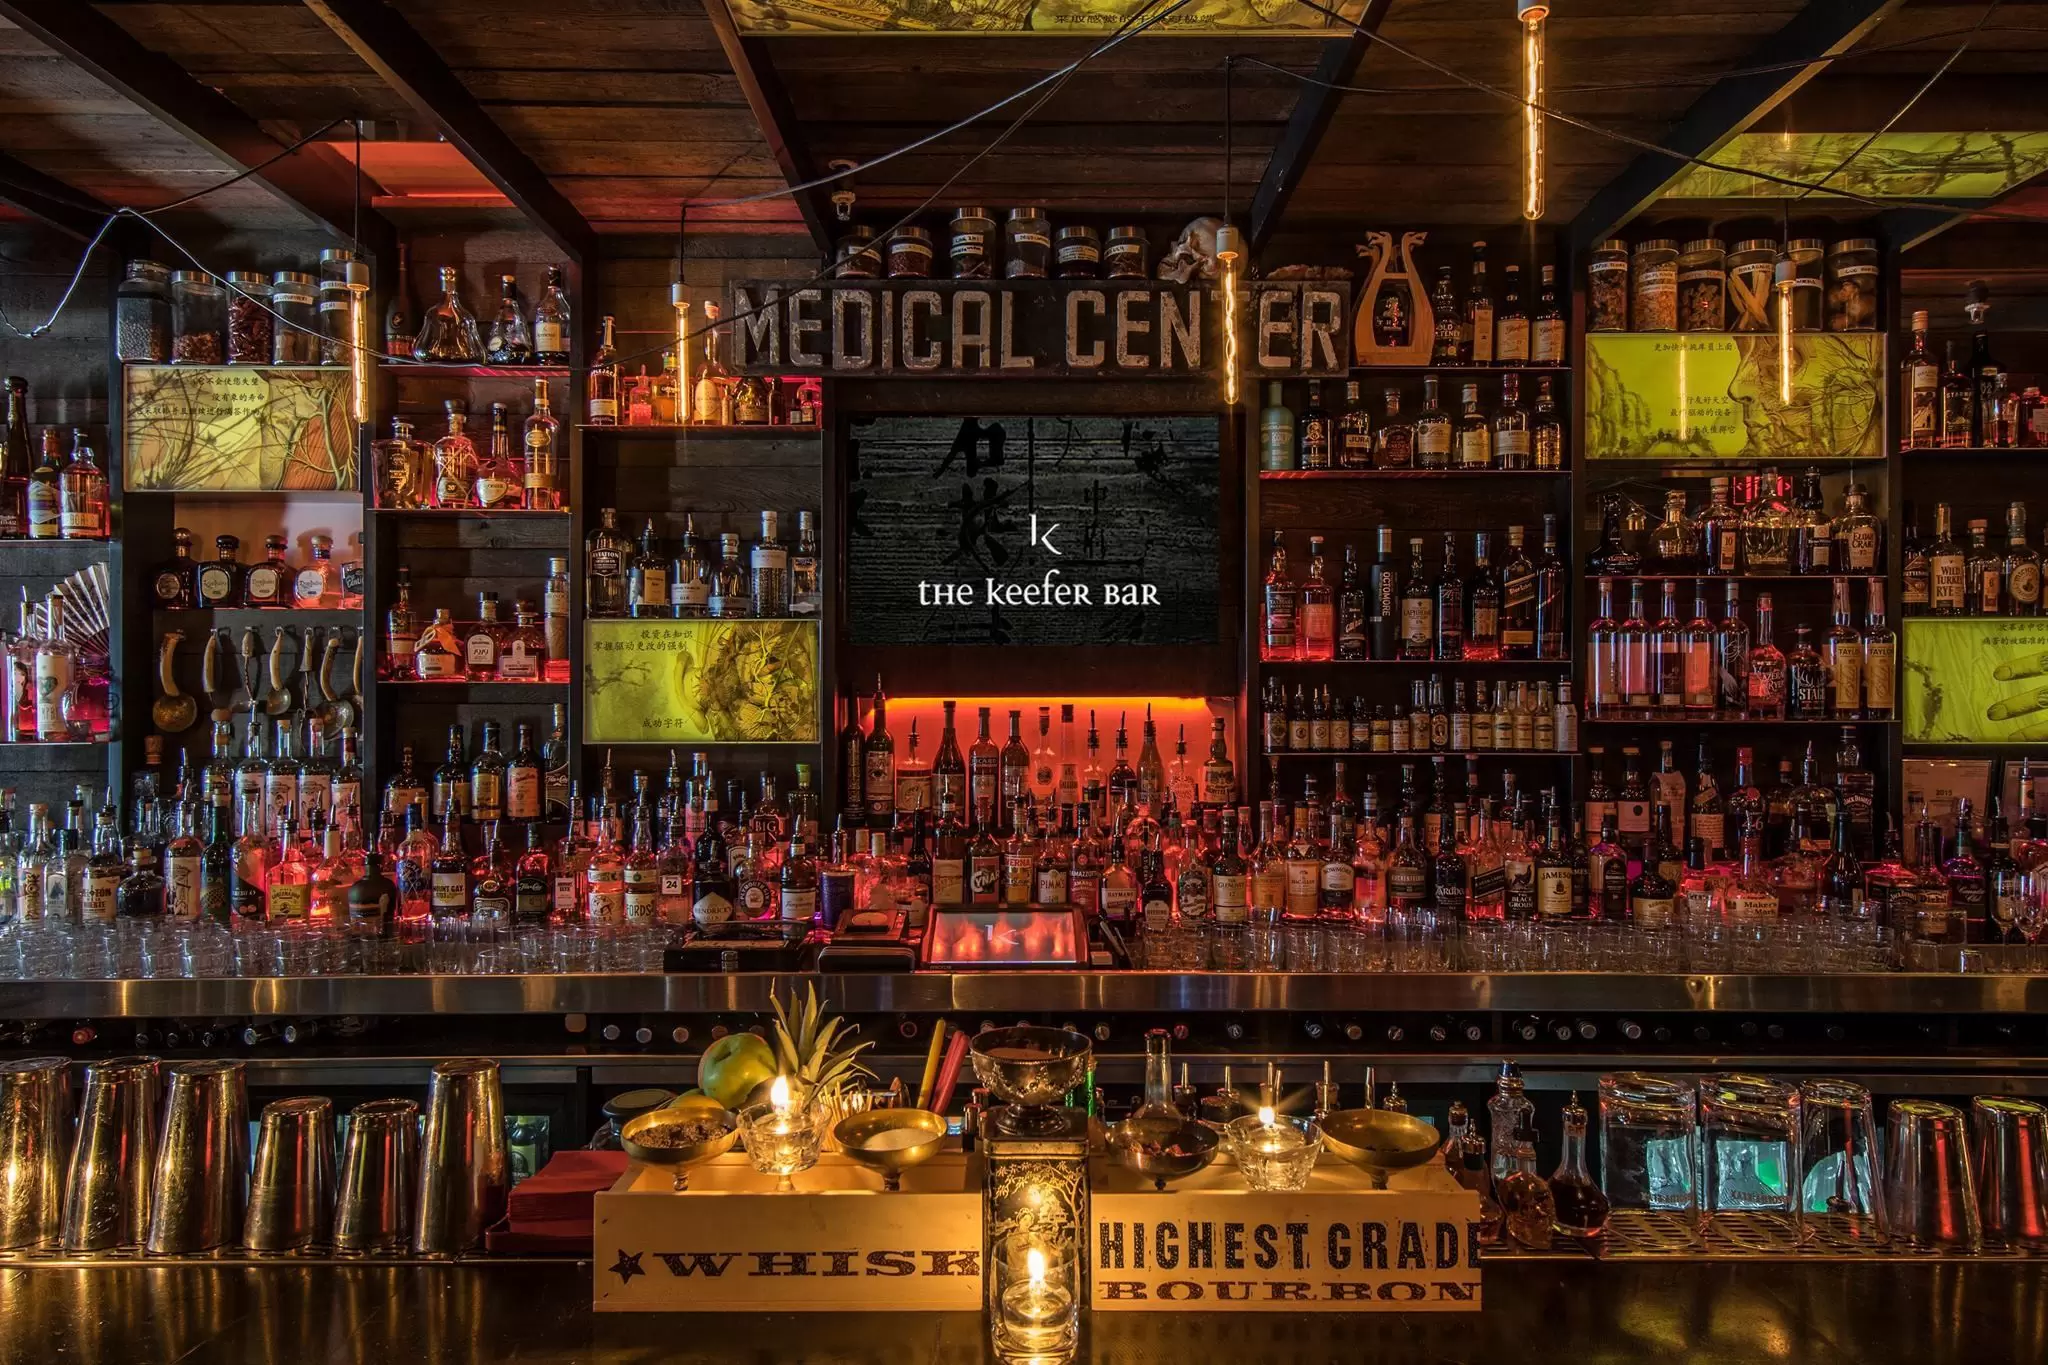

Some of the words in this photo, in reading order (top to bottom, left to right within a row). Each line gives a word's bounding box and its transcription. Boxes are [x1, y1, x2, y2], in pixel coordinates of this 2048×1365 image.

[734, 287, 1035, 370] MEDICAL
[1066, 289, 1341, 371] CENTER
[1349, 435, 1369, 443] JURA
[1941, 566, 1960, 575] WILD
[1936, 575, 1963, 584] TURKE
[1382, 571, 1392, 617] OCTOMORE
[1937, 586, 1954, 597] RYE
[1838, 648, 1859, 656] TAYLO
[1870, 648, 1893, 656] TAYLO
[755, 820, 776, 832] BIG
[666, 880, 677, 889] 24
[971, 870, 1000, 893] CYNAR
[626, 902, 651, 917] FORDS
[1099, 1221, 1309, 1269] HIGHEST
[1327, 1221, 1481, 1269] GRADE
[1099, 1280, 1481, 1301] BOURBON
